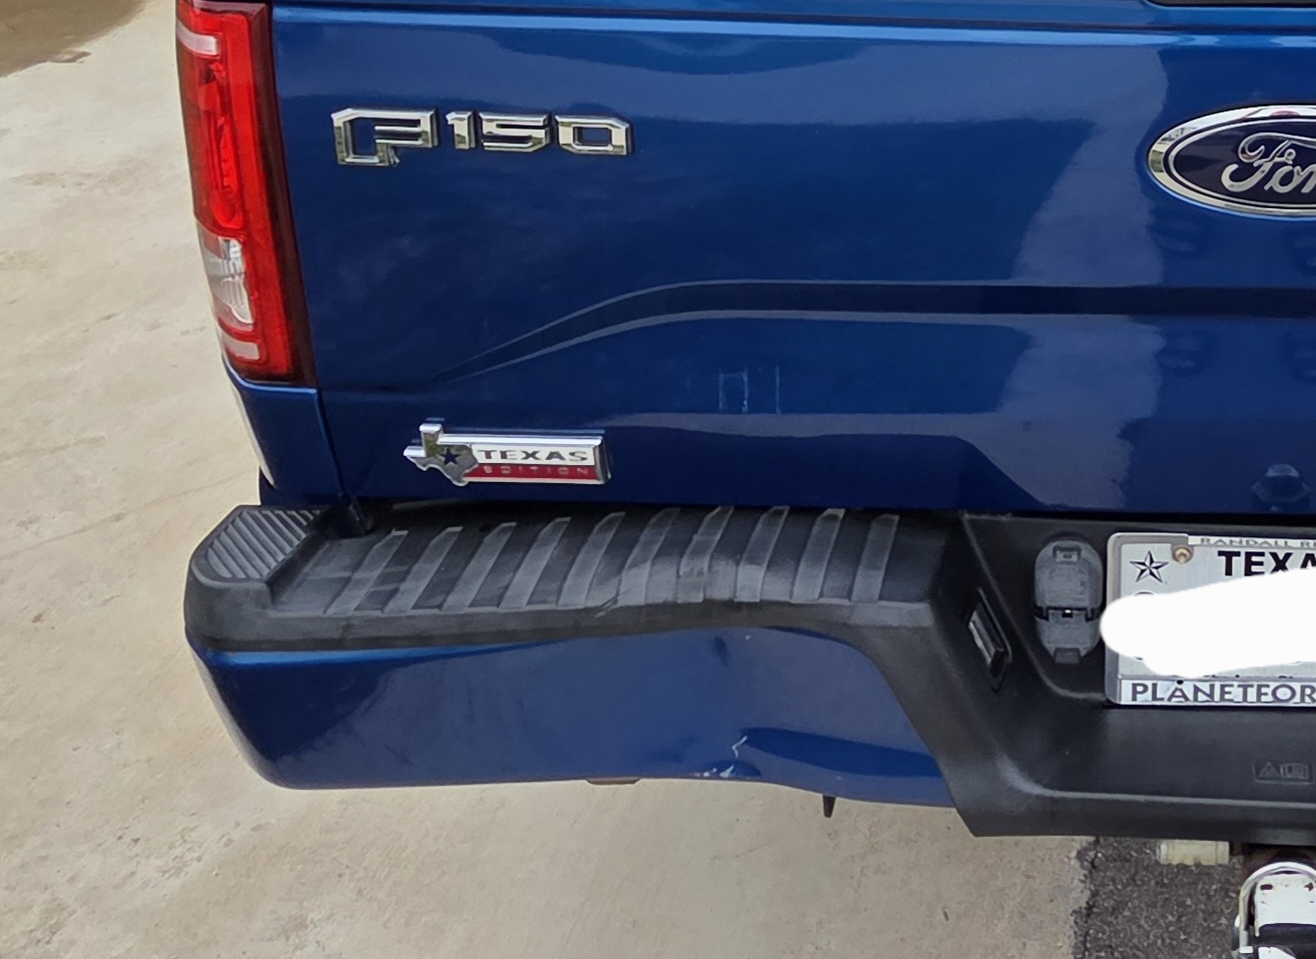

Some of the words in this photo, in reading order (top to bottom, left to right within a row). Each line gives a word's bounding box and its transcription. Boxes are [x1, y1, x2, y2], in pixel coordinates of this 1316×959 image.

[477, 449, 588, 462] TEXAS
[483, 465, 588, 476] EDITION
[1200, 536, 1289, 548] RANDALL
